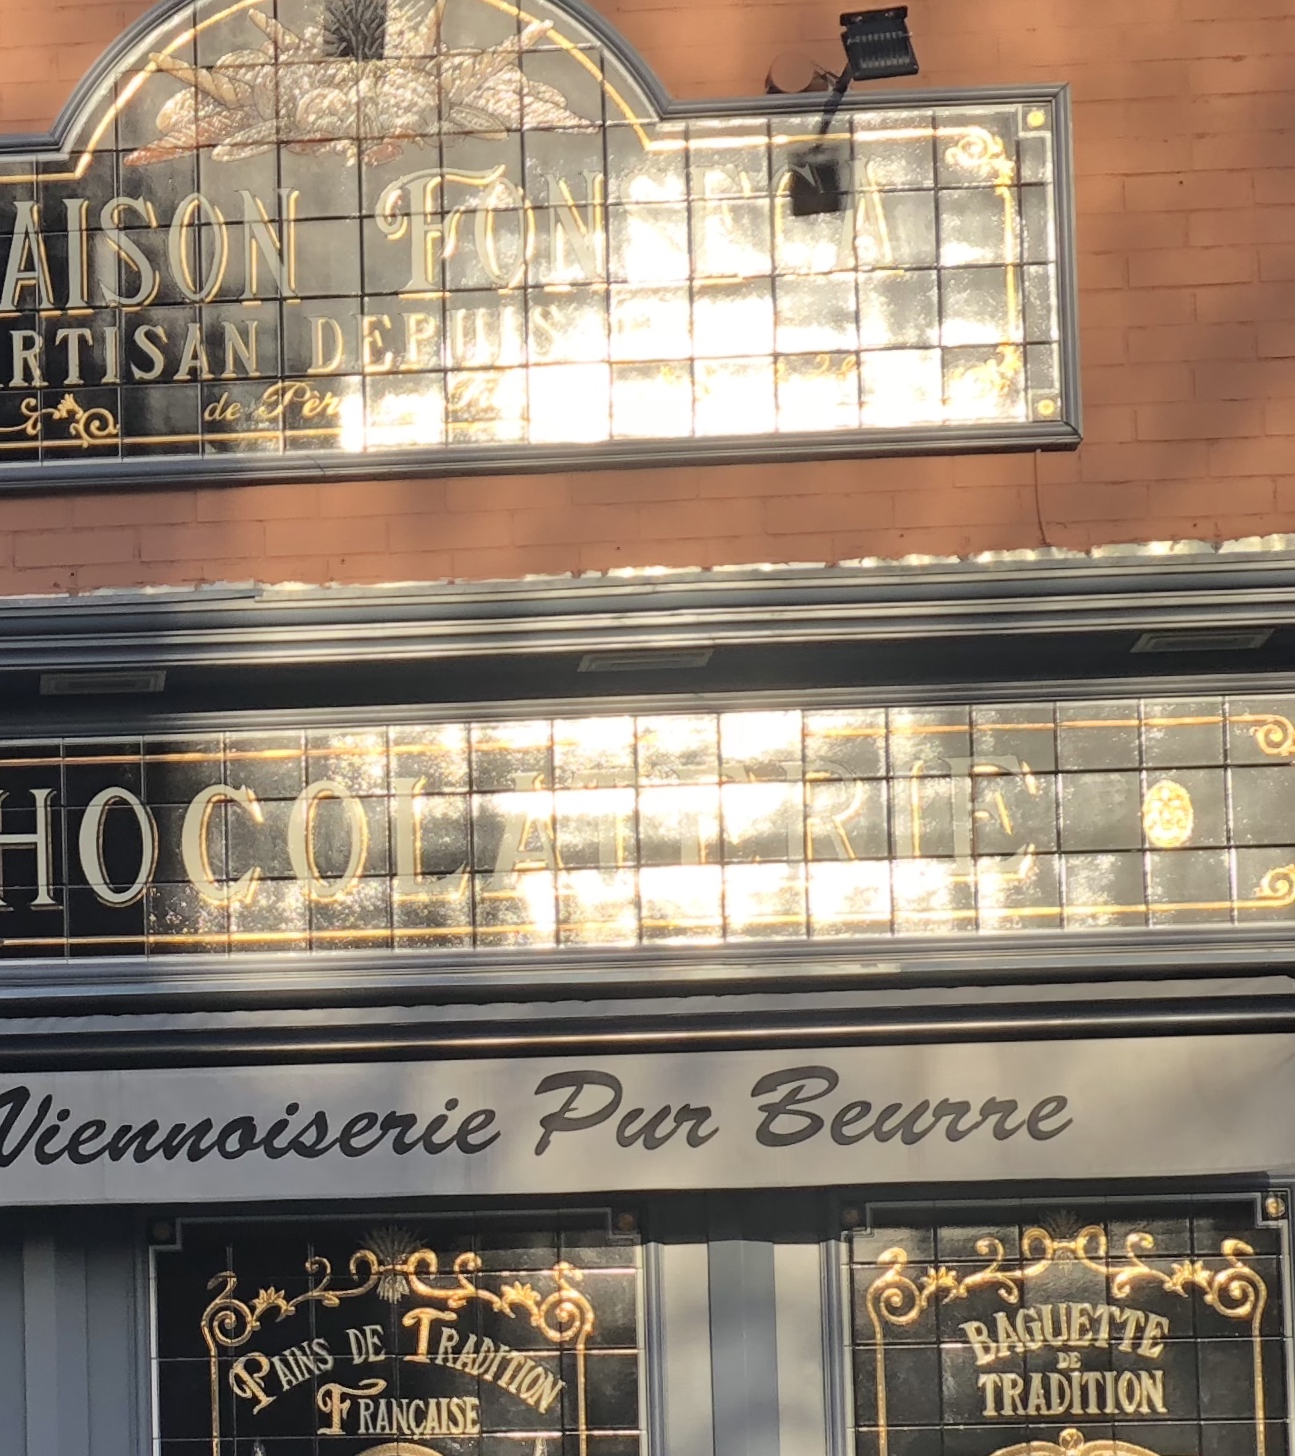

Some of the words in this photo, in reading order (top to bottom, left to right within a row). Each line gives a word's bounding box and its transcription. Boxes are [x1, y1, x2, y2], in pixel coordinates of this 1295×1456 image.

[309, 304, 566, 374] DEPUIS
[204, 391, 242, 422] de
[258, 381, 359, 419] Pèr
[533, 1070, 719, 1158] Pur
[751, 1065, 1073, 1148] Beurre
[229, 1338, 335, 1414] PAINS
[345, 1325, 387, 1365] DE
[402, 1308, 568, 1415] TRADITION
[958, 1302, 1170, 1366] BAGUETTE
[1056, 1351, 1081, 1370] DE
[316, 1379, 481, 1440] FRANÇAISE
[977, 1368, 1169, 1417] TRADITION
